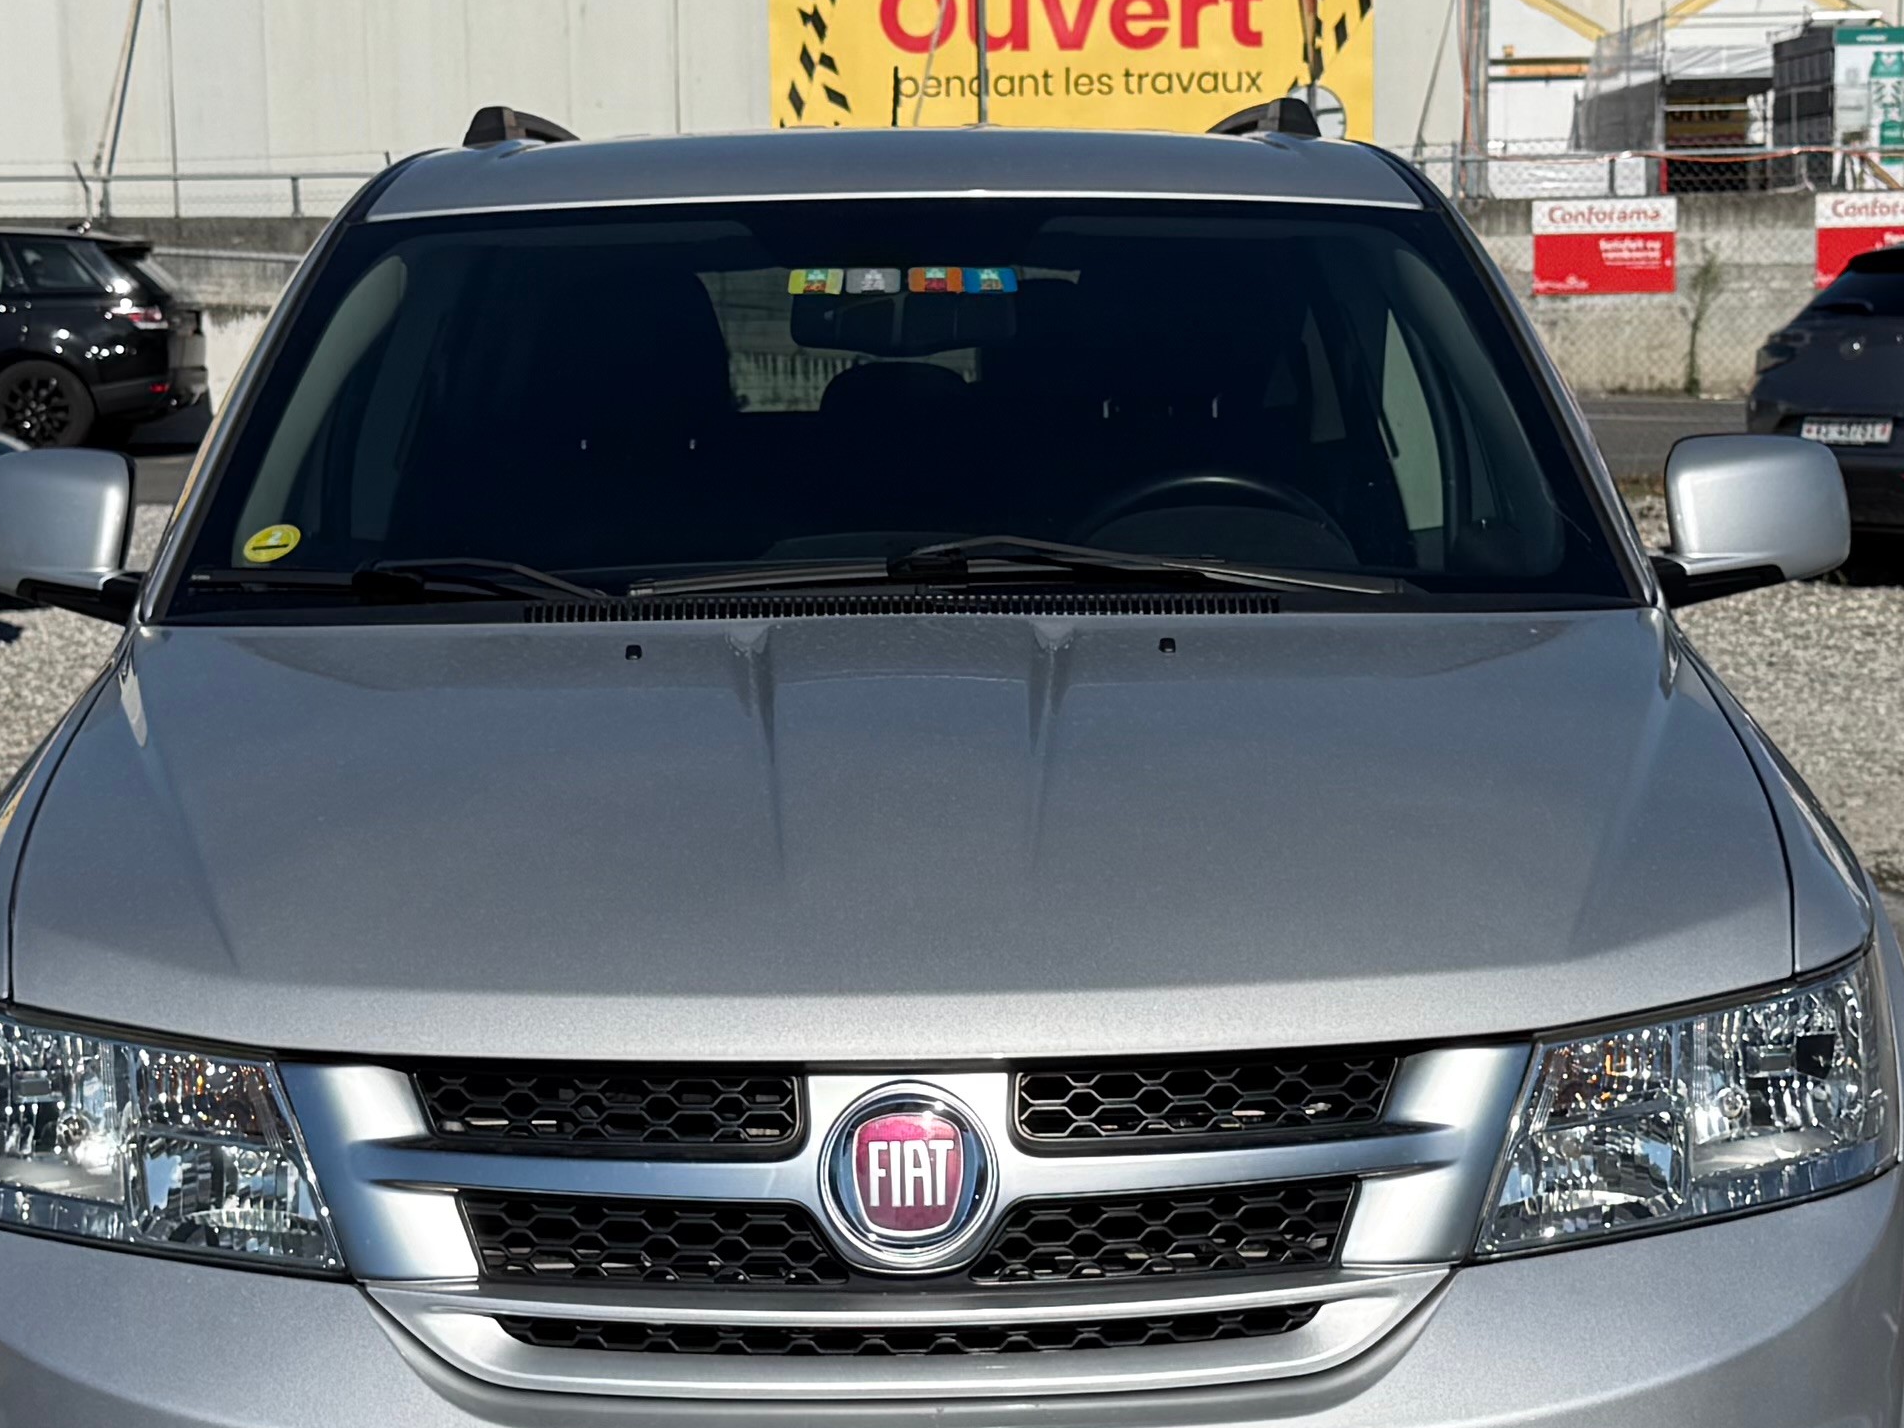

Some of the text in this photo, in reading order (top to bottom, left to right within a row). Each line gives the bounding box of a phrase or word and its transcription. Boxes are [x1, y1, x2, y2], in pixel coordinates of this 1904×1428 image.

[1064, 68, 1114, 96] les
[1123, 68, 1264, 95] travaux
[1548, 206, 1662, 225] Conforama
[868, 1139, 955, 1208] FIAT
